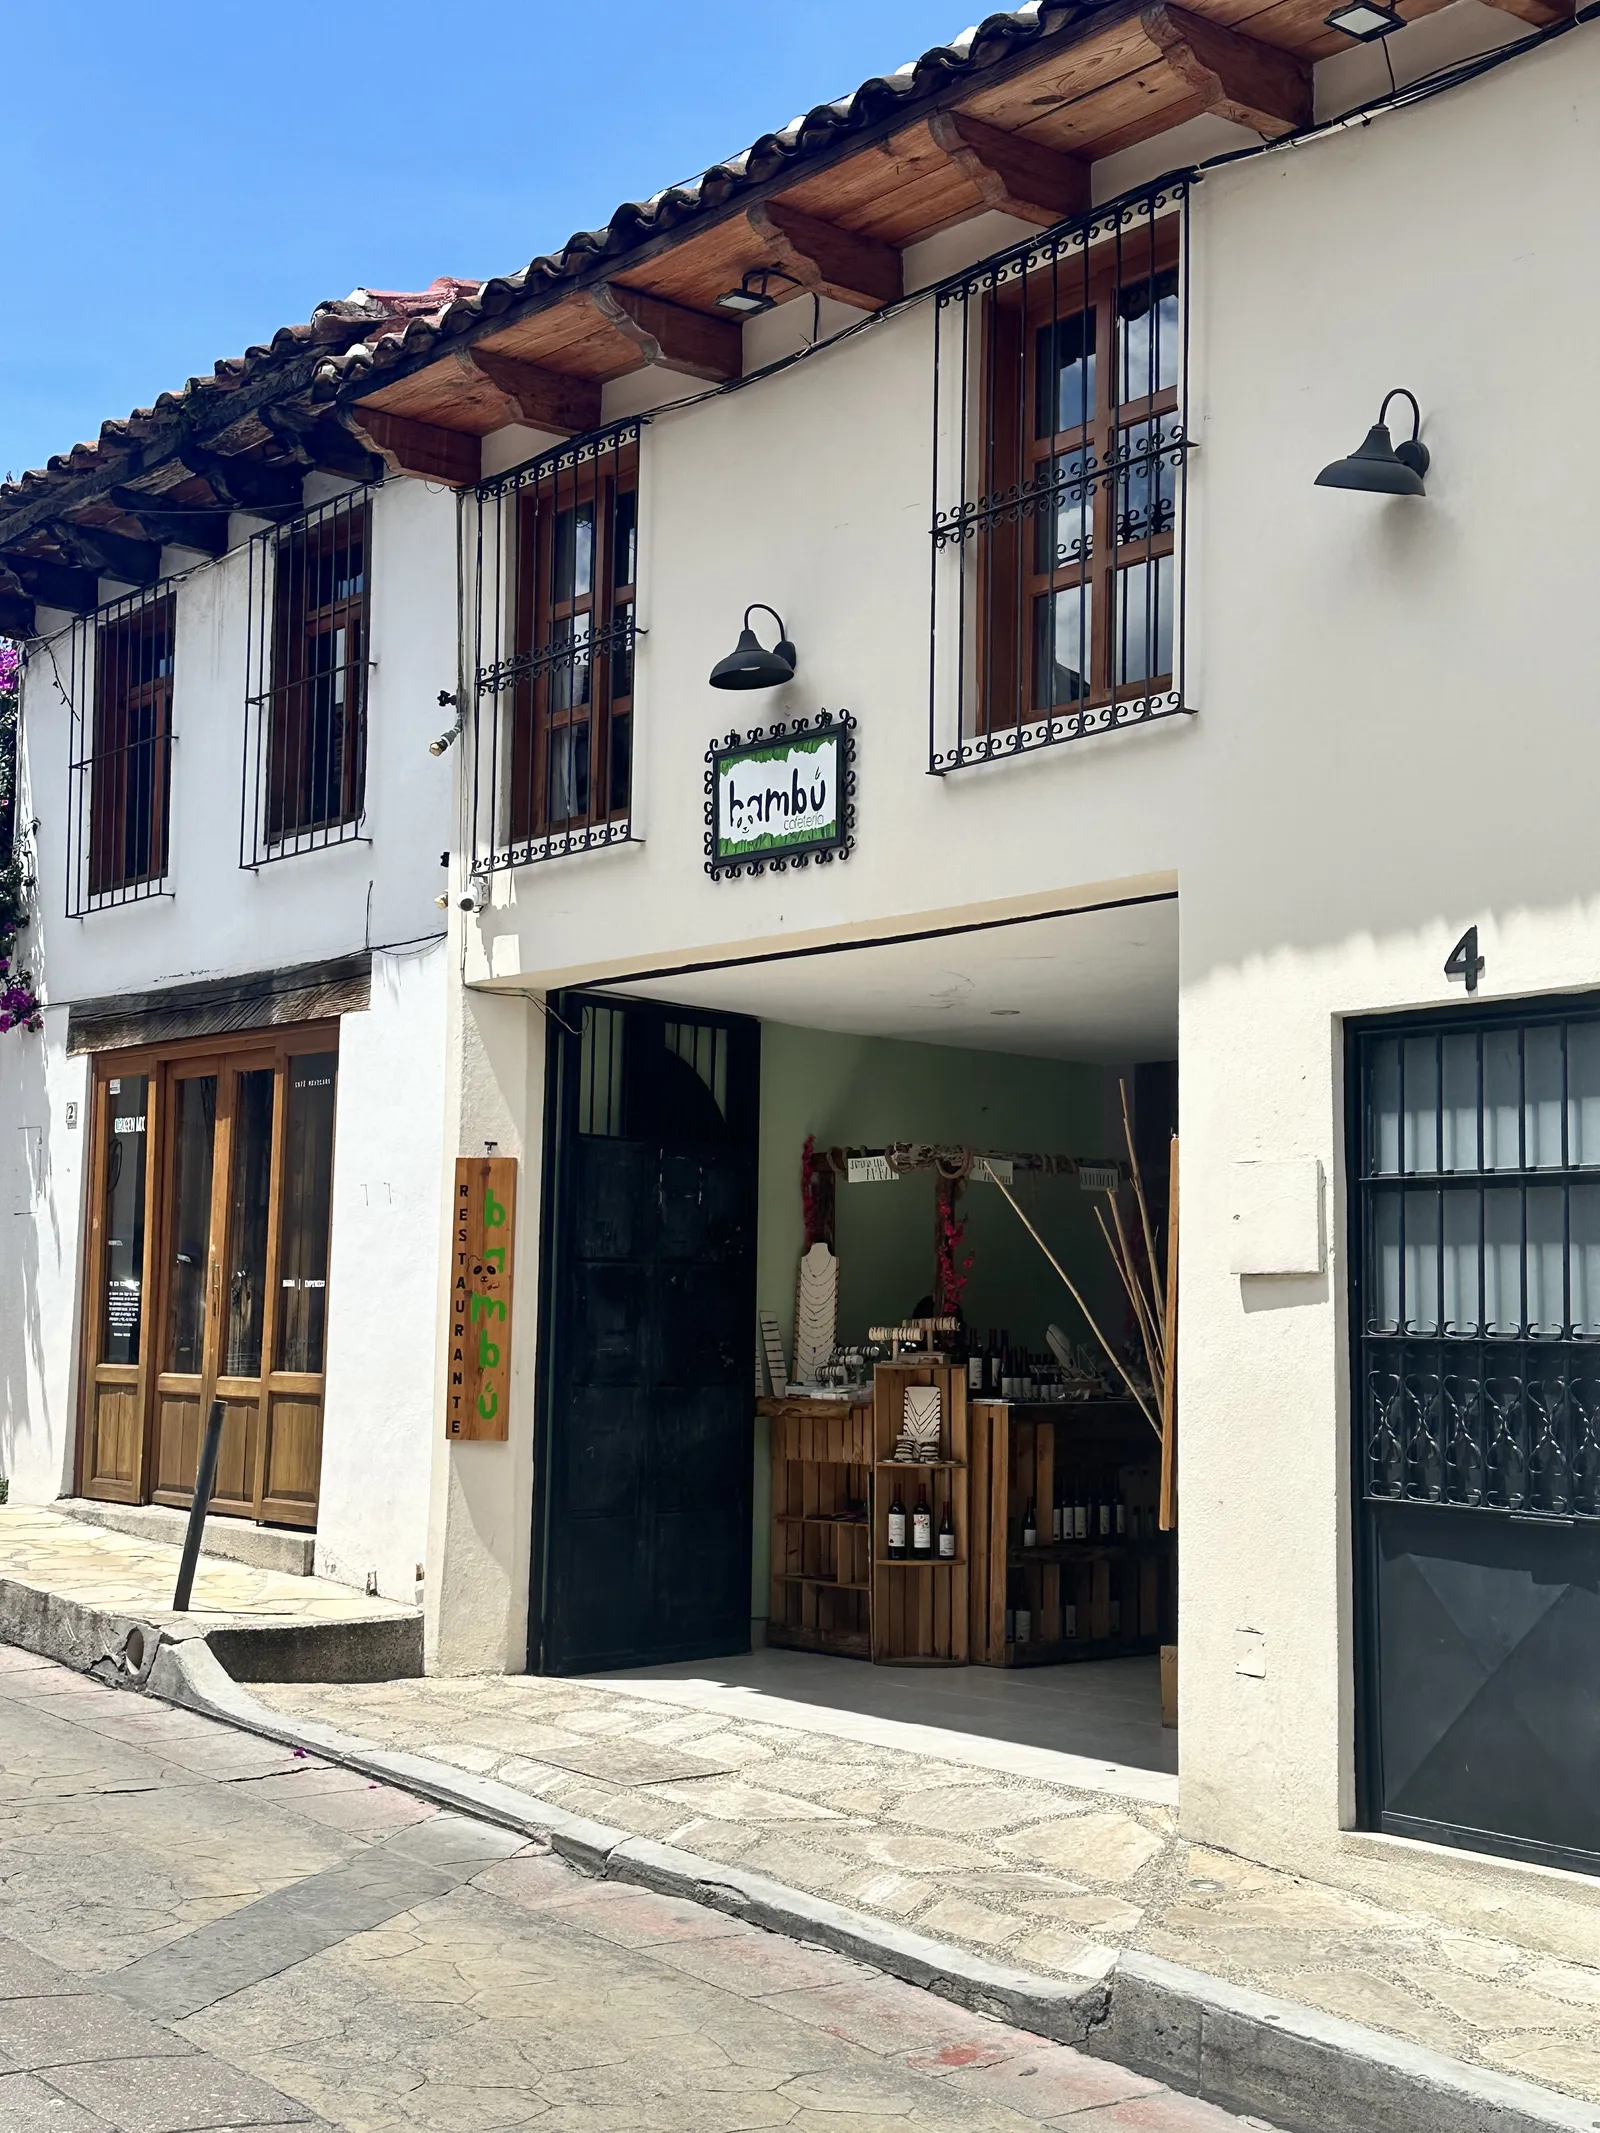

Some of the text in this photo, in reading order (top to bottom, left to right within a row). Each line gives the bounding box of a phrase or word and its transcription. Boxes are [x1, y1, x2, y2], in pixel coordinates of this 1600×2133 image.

[729, 766, 827, 828] bambú
[783, 811, 825, 831] cafetería
[1444, 925, 1485, 991] 4
[452, 1184, 469, 1434] RESTAURANTE
